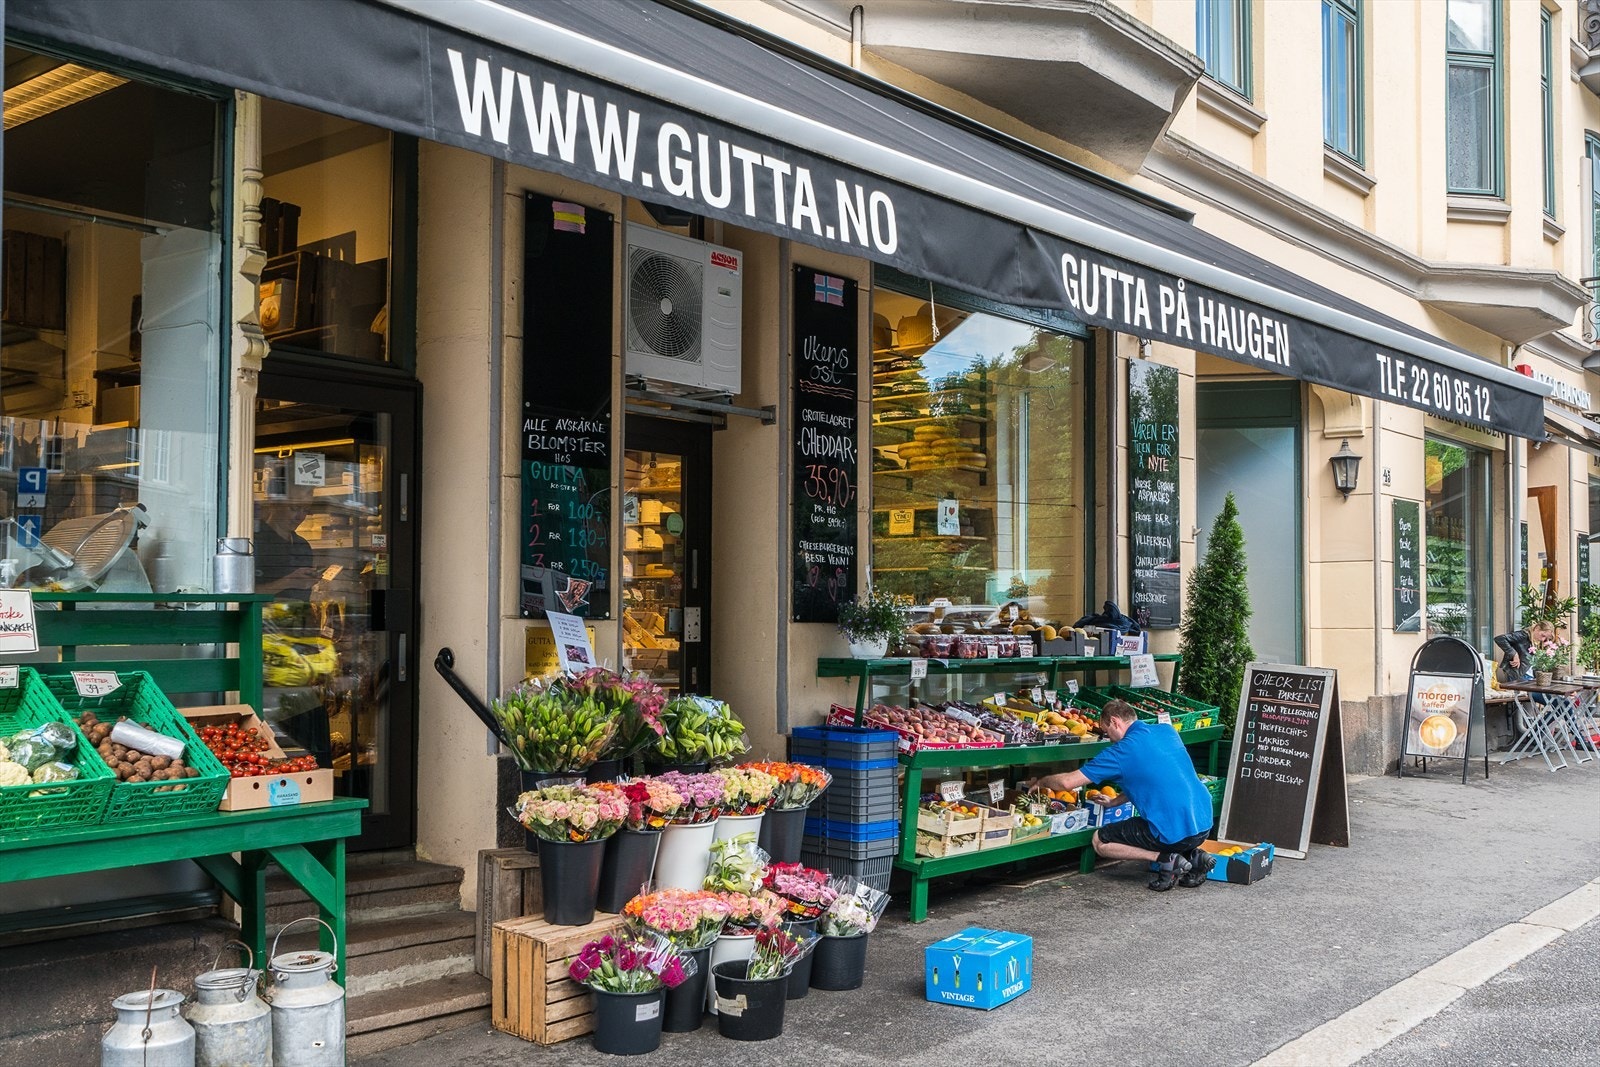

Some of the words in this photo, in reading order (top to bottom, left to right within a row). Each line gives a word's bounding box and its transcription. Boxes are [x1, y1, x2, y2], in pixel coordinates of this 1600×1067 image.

[447, 48, 898, 255] WWW.GUTTA.NO
[1061, 253, 1152, 330] GUTTA
[1161, 278, 1193, 341] PÅ
[1199, 296, 1291, 367] HAUGEN
[810, 363, 850, 384] ost
[1376, 353, 1408, 399] TLF.
[1411, 364, 1430, 406] 22
[1433, 372, 1451, 412] 60
[1454, 379, 1472, 417] 85
[1474, 385, 1491, 422] 12
[523, 419, 549, 432] ALLE
[1162, 424, 1175, 441] ER
[528, 435, 606, 456] BLOMSTER
[1157, 443, 1171, 456] FOR
[1148, 454, 1169, 472] NYTE
[531, 461, 586, 486] GUTTA
[1138, 489, 1170, 504] ASPARGES
[530, 499, 542, 517] 1
[548, 503, 560, 511] FOR
[528, 524, 545, 546] 2
[549, 532, 561, 540] FOR
[531, 553, 545, 578] 3
[805, 553, 826, 563] BESTE
[828, 554, 849, 569] VENN!
[528, 636, 551, 645] GUTTA
[1253, 673, 1293, 689] CHECK
[1278, 689, 1314, 704] PARKEN
[1417, 691, 1465, 704] morgen-
[1262, 704, 1276, 713] SAN
[1422, 701, 1445, 709] kaffen
[1255, 755, 1292, 768] JORDBÆR
[1254, 768, 1275, 779] GODT
[941, 990, 975, 1003] VINTAGE
[1001, 980, 1024, 999] VINTAGE
